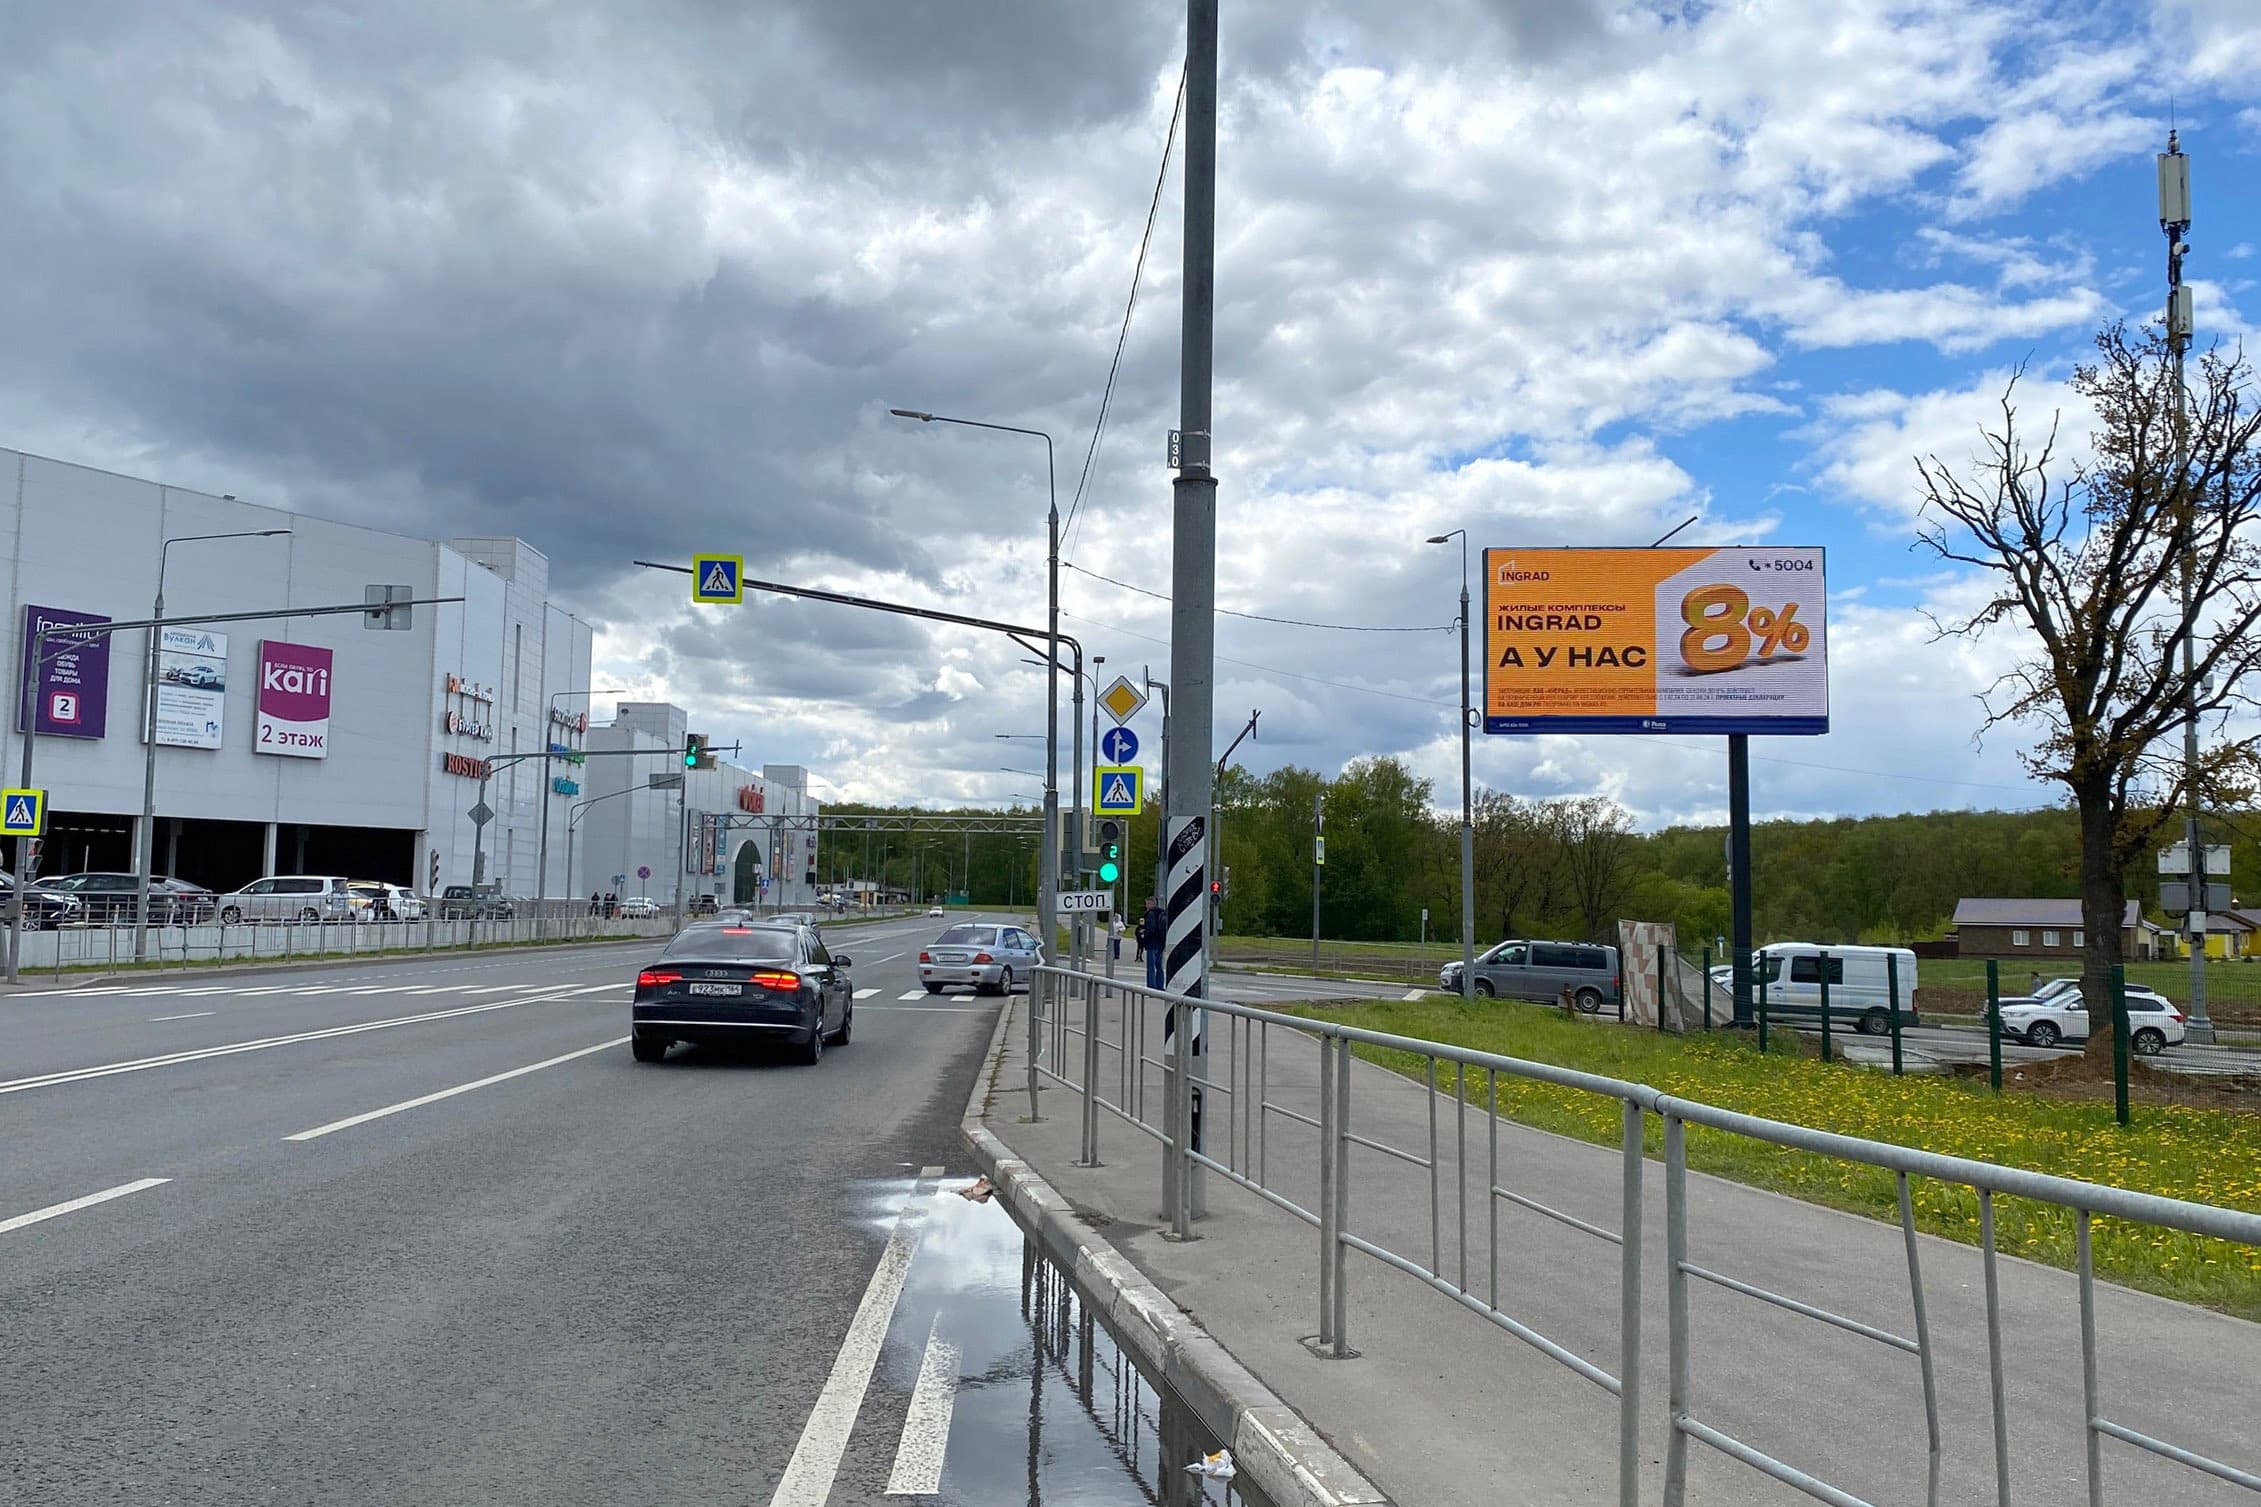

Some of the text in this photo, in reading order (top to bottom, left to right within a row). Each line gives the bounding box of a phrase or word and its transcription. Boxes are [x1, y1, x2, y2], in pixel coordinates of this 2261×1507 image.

[1501, 571, 1550, 581] INGRAD
[1498, 604, 1626, 612] ЖИЛЫЕ КОМПЛЕКСЫ
[1498, 615, 1602, 631] INGRAD
[1680, 583, 1810, 672] 8%
[1499, 647, 1647, 668] А У НАС
[264, 661, 328, 697] kari
[60, 698, 70, 712] 2
[261, 724, 324, 749] 2 этаж
[1109, 845, 1118, 859] 2
[1063, 894, 1105, 909] СТОП
